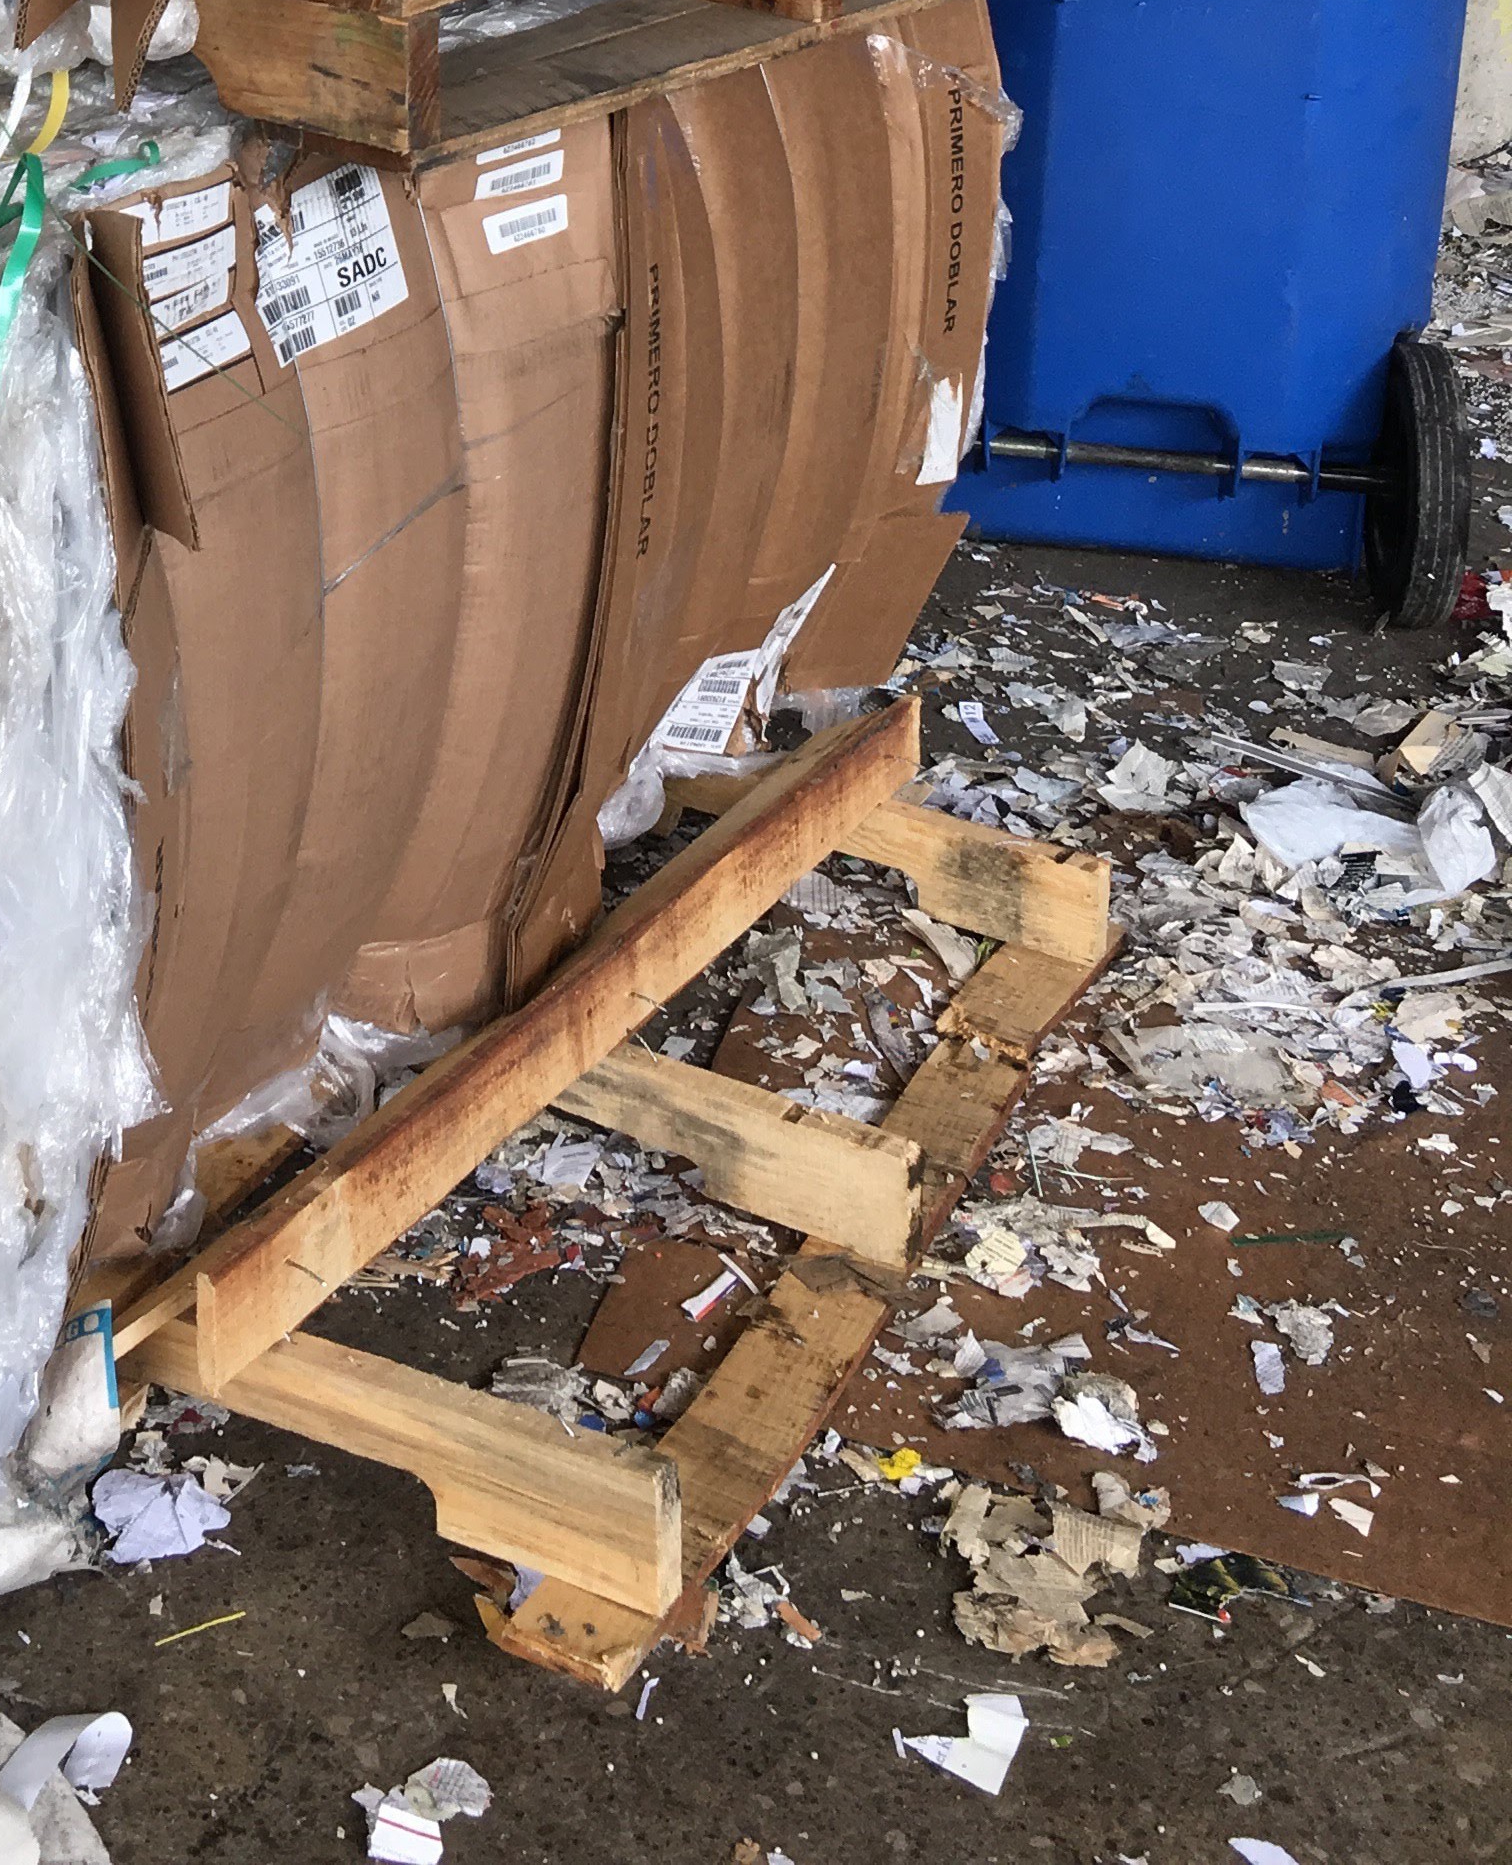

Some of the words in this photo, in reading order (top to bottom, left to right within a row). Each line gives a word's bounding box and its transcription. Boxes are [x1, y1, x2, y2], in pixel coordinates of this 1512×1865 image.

[947, 88, 965, 215] PRIMERO
[337, 246, 388, 288] SADC
[942, 222, 963, 335] DOBLAR
[647, 262, 661, 416] PRIMERO
[635, 423, 660, 560] DOBLAR
